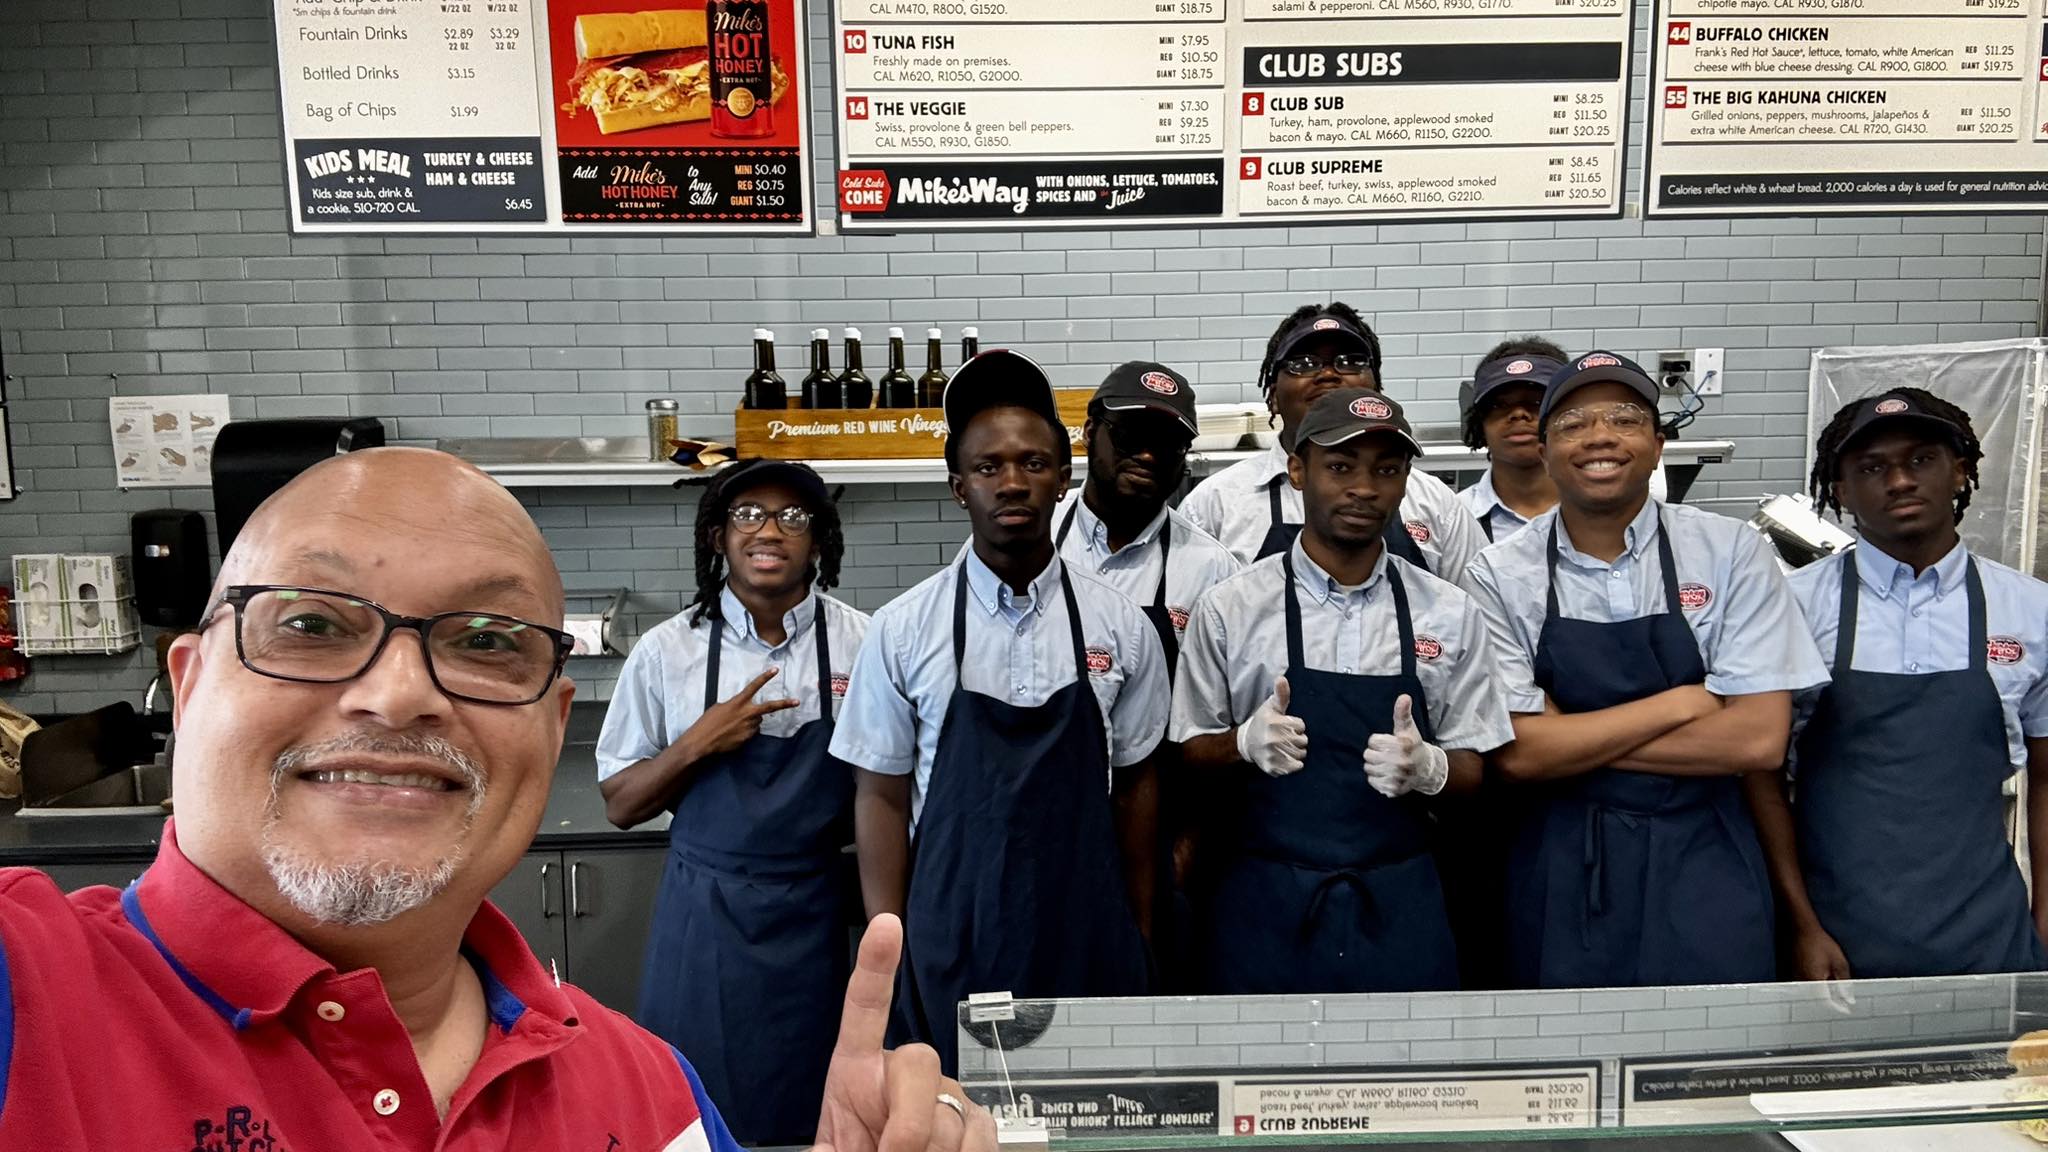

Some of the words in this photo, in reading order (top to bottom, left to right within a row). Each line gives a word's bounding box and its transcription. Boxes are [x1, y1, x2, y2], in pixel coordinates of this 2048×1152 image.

[714, 8, 762, 31] Mike's
[299, 27, 359, 41] Fountain
[365, 25, 408, 40] Drinks
[444, 28, 473, 40] $2.89
[490, 27, 520, 40] $3.29
[1669, 27, 1690, 41] 44
[1696, 27, 1763, 41] BUFFALO
[1768, 27, 1829, 41] CHICKEN
[714, 32, 763, 59] HOT
[846, 35, 864, 49] 10
[872, 35, 916, 49] TUNA
[922, 35, 954, 49] FISH
[1181, 35, 1209, 46] $7.95
[1181, 51, 1218, 63] $10.50
[1695, 46, 1727, 57] Frank's
[1731, 46, 1749, 57] Red
[1752, 47, 1769, 57] Hot
[1808, 46, 1842, 58] lettuce,
[1845, 48, 1880, 57] tomato,
[1882, 46, 1908, 57] white
[1910, 47, 1954, 57] American
[1985, 45, 2014, 56] $11.25
[715, 58, 762, 74] HONEY
[873, 55, 909, 70] Freshly
[913, 55, 942, 66] made
[946, 58, 959, 66] on
[964, 57, 1011, 69] premises.
[1259, 53, 1325, 78] CLUB
[1336, 52, 1402, 77] SUBS
[303, 65, 351, 80] Bottled
[356, 65, 399, 80] Drinks
[448, 67, 475, 80] $3.15
[1270, 97, 1308, 111] CLUB
[1314, 96, 1344, 110] SUB
[1575, 93, 1604, 104] $8.25
[1666, 91, 1686, 105] 55
[1693, 91, 1721, 104] THE
[1727, 91, 1752, 104] BIG
[1758, 91, 1821, 104] KAHUNA
[1827, 90, 1886, 104] CHICKEN
[848, 102, 866, 115] 14
[874, 102, 904, 116] THE
[910, 102, 966, 116] VEGGIE
[1180, 100, 1209, 112] $7.30
[1247, 97, 1259, 112] 8
[306, 103, 334, 122] Bag
[338, 102, 353, 117] of
[357, 102, 397, 120] Chips
[450, 106, 479, 118] $1.99
[1574, 109, 1607, 121] $11.50
[1691, 110, 1724, 121] Grilled
[1727, 111, 1763, 121] onions,
[1766, 112, 1808, 123] peppers,
[1811, 109, 1869, 120] mushrooms,
[1870, 109, 1919, 123] jalapeños
[1922, 109, 1929, 119] &
[1980, 107, 2011, 118] $11.50
[875, 121, 906, 133] Swiss,
[909, 121, 960, 135] provolone
[964, 121, 972, 132] &
[976, 124, 1005, 135] green
[1009, 120, 1027, 132] bell
[1031, 123, 1074, 134] peppers.
[1180, 117, 1209, 128] $9.25
[1270, 116, 1304, 130] Turkey,
[1308, 116, 1333, 127] ham,
[1337, 114, 1390, 129] provolone,
[1393, 113, 1451, 127] applewood
[1454, 112, 1494, 124] smoked
[1269, 132, 1301, 142] bacon
[1304, 131, 1312, 142] &
[1316, 133, 1346, 144] mayo.
[1350, 130, 1372, 141] CAL
[1375, 129, 1410, 140] M660,
[1415, 128, 1448, 140] R1150,
[1452, 127, 1492, 138] G2200.
[1573, 125, 1610, 137] $20.25
[304, 149, 353, 179] KIDS
[358, 149, 411, 178] MEAL
[423, 152, 471, 166] TURKEY
[475, 152, 485, 166] &
[489, 152, 533, 165] CHEESE
[1570, 156, 1599, 168] $8.45
[573, 166, 598, 179] Add
[610, 161, 665, 185] Mike's
[688, 165, 699, 177] to
[735, 165, 752, 174] MINI
[755, 164, 786, 175] $0.40
[1246, 162, 1257, 176] 9
[1268, 161, 1305, 175] CLUB
[1311, 159, 1382, 174] SUPREME
[425, 172, 454, 186] HAM
[458, 172, 467, 185] &
[471, 172, 515, 185] CHEESE
[737, 180, 753, 190] REG
[755, 179, 784, 191] $0.75
[1036, 176, 1064, 188] WITH
[1067, 175, 1110, 187] ONIONS,
[1113, 174, 1158, 187] LETTUCE,
[1161, 172, 1218, 185] TOMATOES,
[312, 188, 332, 199] Kids
[335, 189, 353, 199] size
[356, 187, 376, 199] sub,
[378, 187, 402, 198] drink
[404, 187, 413, 198] &
[602, 185, 629, 198] HOT
[631, 185, 678, 199] HONEY
[689, 178, 712, 198] Any
[1668, 184, 1702, 195] Calories
[1704, 183, 1731, 194] reflect
[1733, 183, 1757, 194] white
[1759, 183, 1766, 193] &
[1768, 182, 1795, 193] wheat
[1797, 182, 1823, 193] bread.
[1825, 182, 1855, 193] 2,000
[1856, 181, 1888, 192] calories
[1889, 184, 1896, 192] a
[1898, 181, 1914, 195] day
[1915, 182, 1922, 191] is
[1924, 181, 1945, 191] used
[1947, 180, 1958, 191] for
[1960, 180, 1991, 195] general
[1993, 182, 2026, 191] nutrition
[2027, 180, 2048, 191] advic
[505, 198, 533, 210] $6.45
[689, 191, 718, 205] Sub!
[730, 196, 753, 206] GIANT
[756, 195, 784, 206] $1.50
[845, 190, 883, 205] COME
[1036, 190, 1071, 203] SPICES
[1073, 190, 1096, 202] AND
[1105, 187, 1145, 210] Juice
[307, 206, 314, 214] a
[316, 202, 351, 214] cookie.
[354, 202, 395, 213] 510-720
[397, 202, 421, 213] CAL.
[767, 421, 841, 439] Premium
[843, 421, 865, 434] RED
[868, 420, 898, 433] WINE
